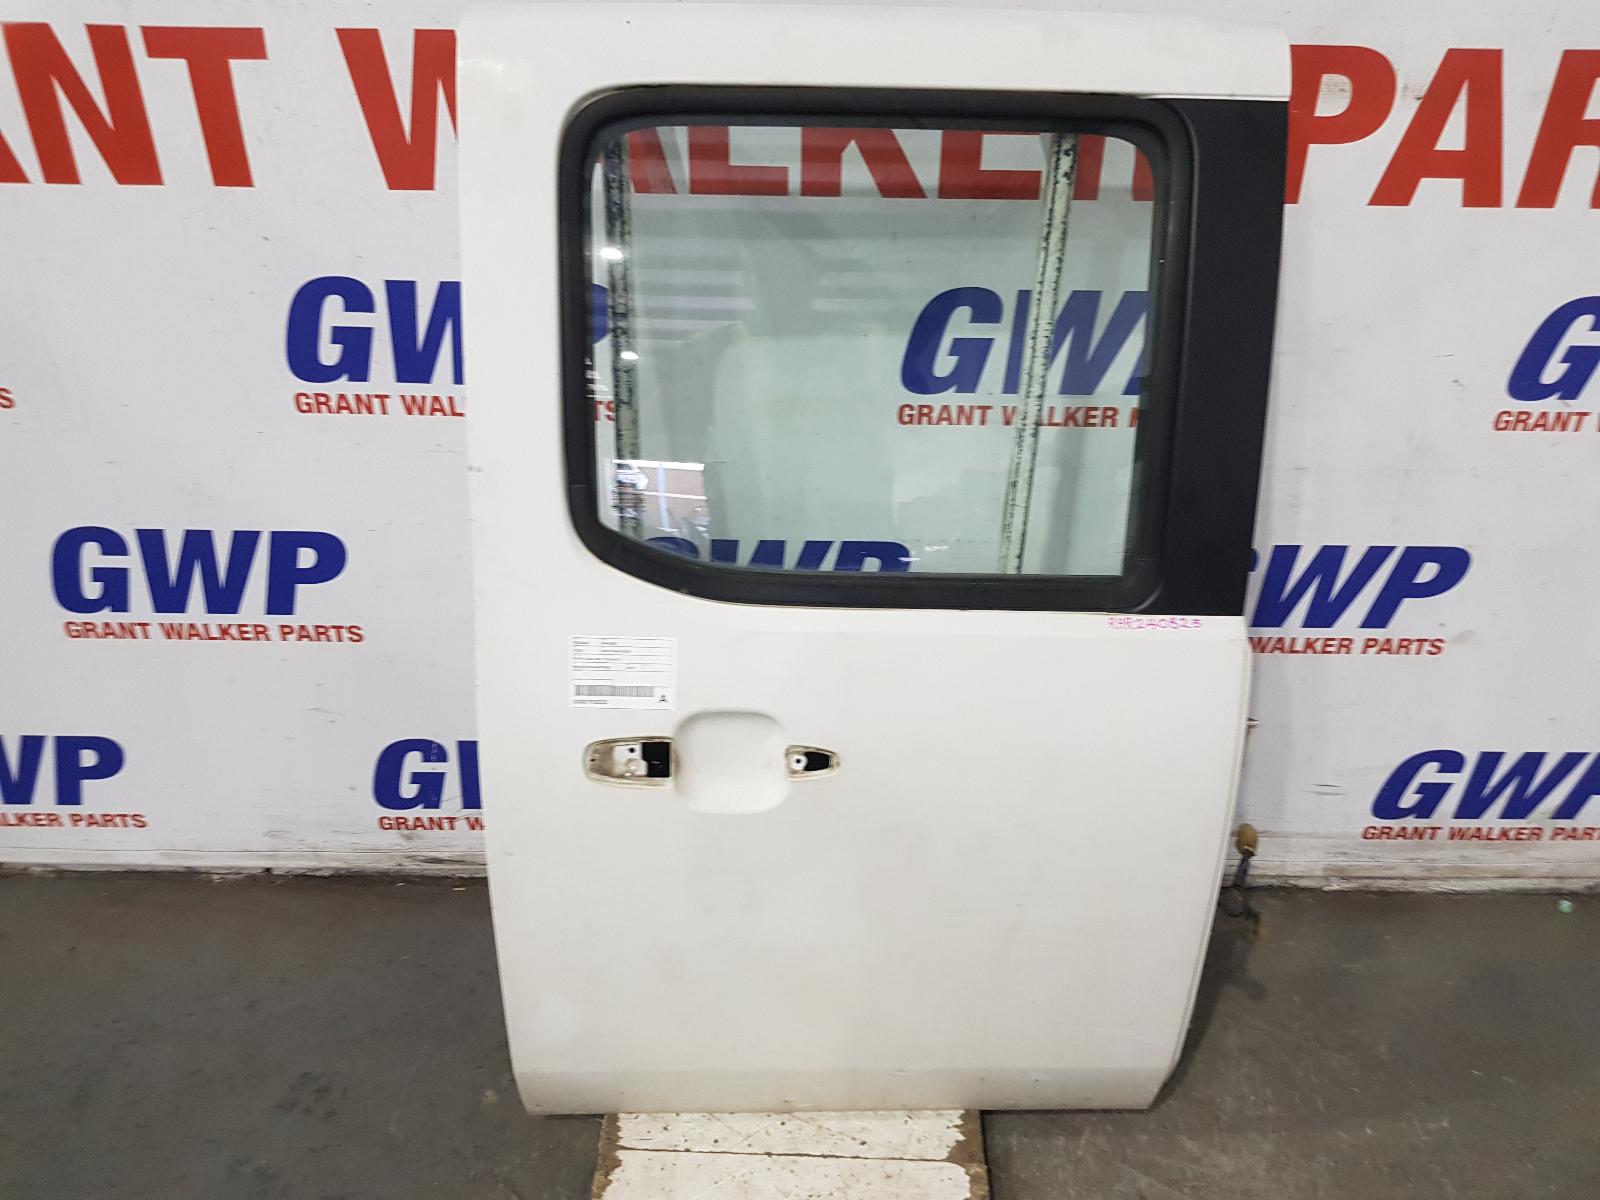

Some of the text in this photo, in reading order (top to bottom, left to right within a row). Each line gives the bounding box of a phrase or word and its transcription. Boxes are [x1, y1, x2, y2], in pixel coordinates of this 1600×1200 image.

[0, 22, 269, 188] NT
[900, 286, 1152, 396] GW
[294, 392, 392, 416] GRANT
[897, 404, 993, 426] GRANT
[1494, 410, 1592, 432] GRANT
[52, 526, 348, 616] GWP
[1248, 544, 1473, 629] WP
[64, 621, 365, 643] GRANT WALKER PARTS
[1249, 636, 1446, 656] WALKER PARTS
[0, 812, 148, 829] LKER PARTS
[378, 815, 457, 831] GRANT
[1361, 825, 1442, 841] GRANT
[1447, 826, 1543, 842] WALKER
